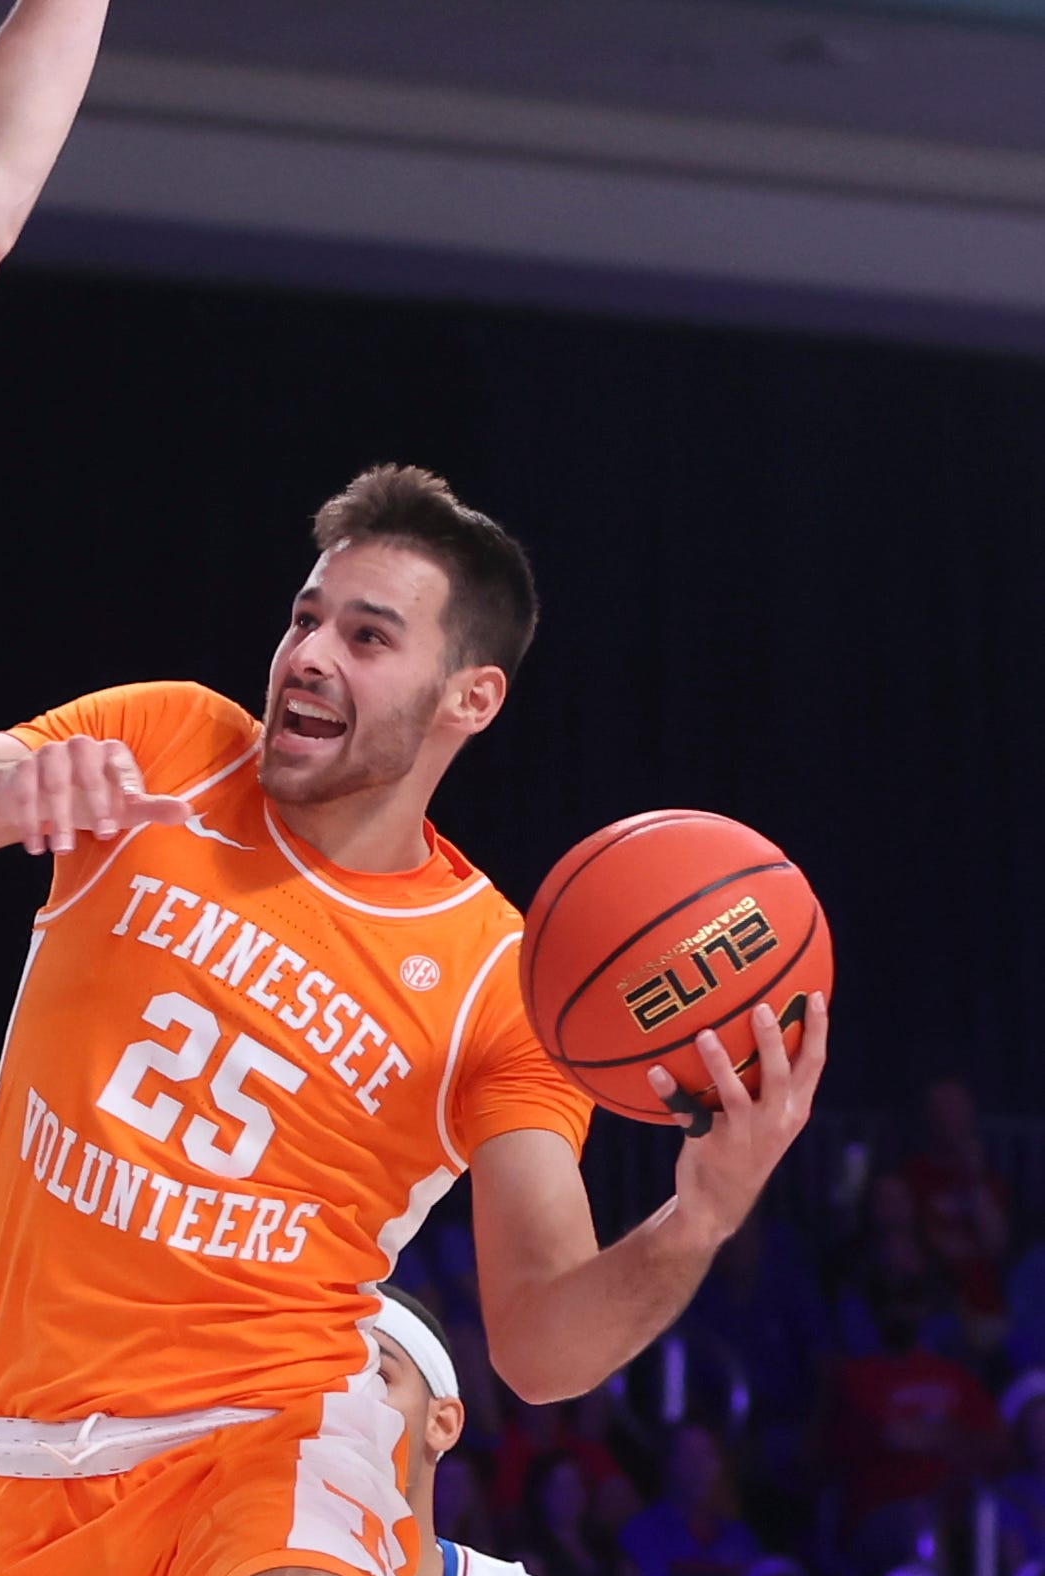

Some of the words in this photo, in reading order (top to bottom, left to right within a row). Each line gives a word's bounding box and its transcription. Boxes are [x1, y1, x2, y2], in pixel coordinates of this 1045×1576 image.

[111, 874, 412, 1116] TENNESSEE
[401, 956, 439, 990] SEC
[623, 907, 780, 1034] ELITE
[95, 991, 308, 1180] 25
[19, 1086, 321, 1264] VOLUNTEERS
